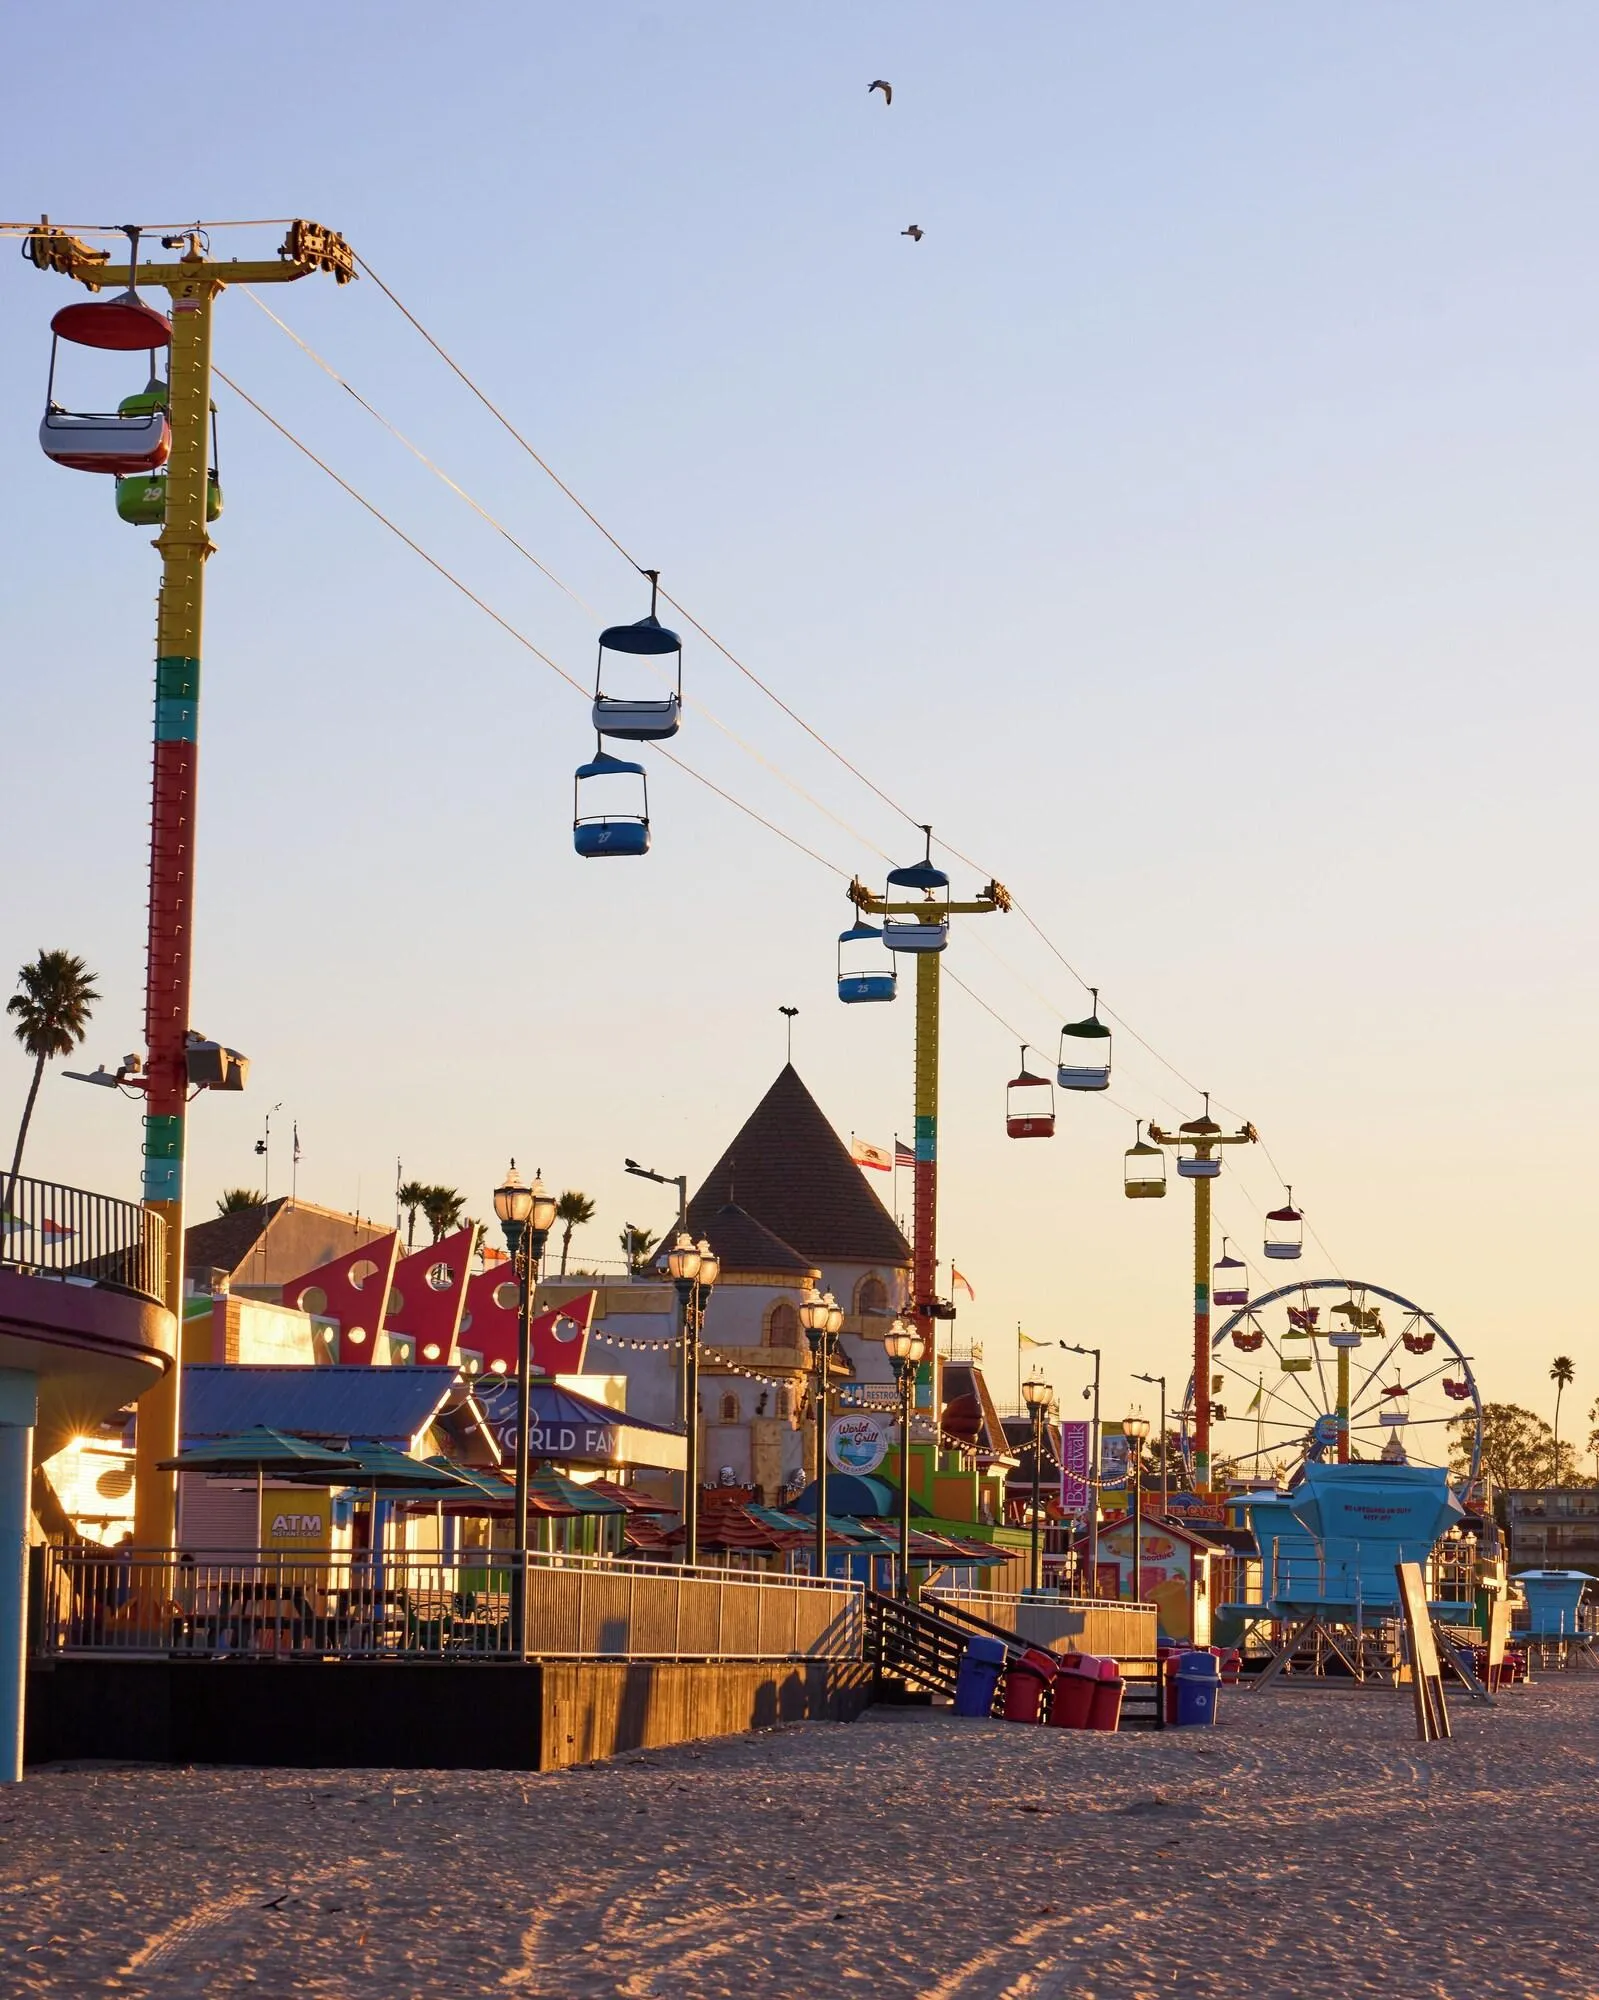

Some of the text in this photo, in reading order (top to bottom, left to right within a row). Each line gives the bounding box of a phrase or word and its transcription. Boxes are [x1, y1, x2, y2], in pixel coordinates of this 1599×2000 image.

[143, 488, 162, 501] 29
[599, 832, 611, 843] 27
[858, 985, 869, 993] 25
[867, 1391, 899, 1400] RESTROO
[839, 1422, 869, 1434] World
[855, 1433, 878, 1445] Grill
[271, 1515, 321, 1531] ATM
[1139, 1552, 1176, 1561] moothies
